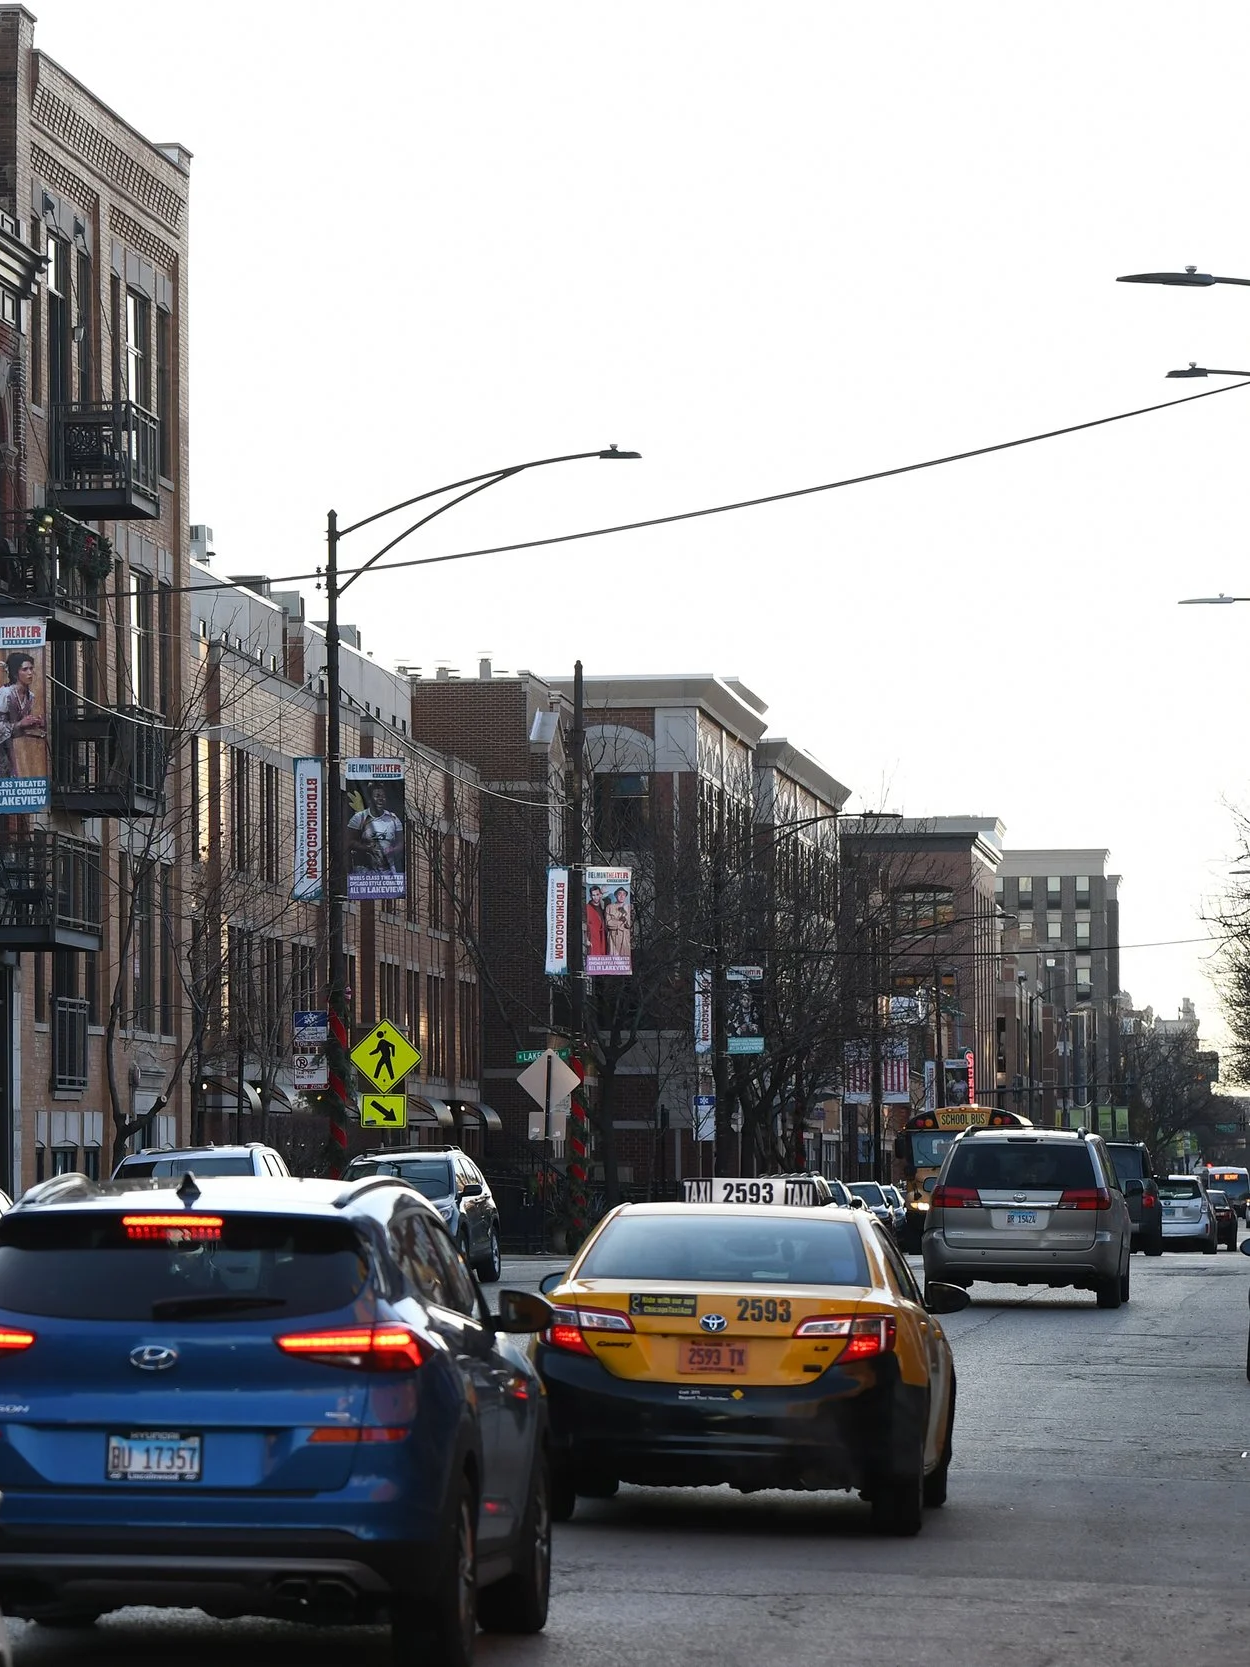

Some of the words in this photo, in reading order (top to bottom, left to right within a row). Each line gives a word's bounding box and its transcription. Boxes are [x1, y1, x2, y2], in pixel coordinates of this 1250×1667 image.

[14, 780, 46, 788] THEATER
[306, 778, 318, 879] BTDCHICAGO.COM
[555, 882, 565, 960] BTDCHICAGO.COM
[941, 1114, 968, 1125] SCHOOL
[971, 1114, 985, 1124] BUS
[683, 1181, 710, 1203] TAXI
[722, 1182, 774, 1204] 2593
[786, 1183, 813, 1206] TAXI
[1018, 1215, 1036, 1224] 15424
[737, 1298, 791, 1322] 2593
[688, 1348, 720, 1366] 2593
[730, 1348, 744, 1366] TX
[111, 1446, 132, 1470] BU
[142, 1447, 197, 1471] 17357
